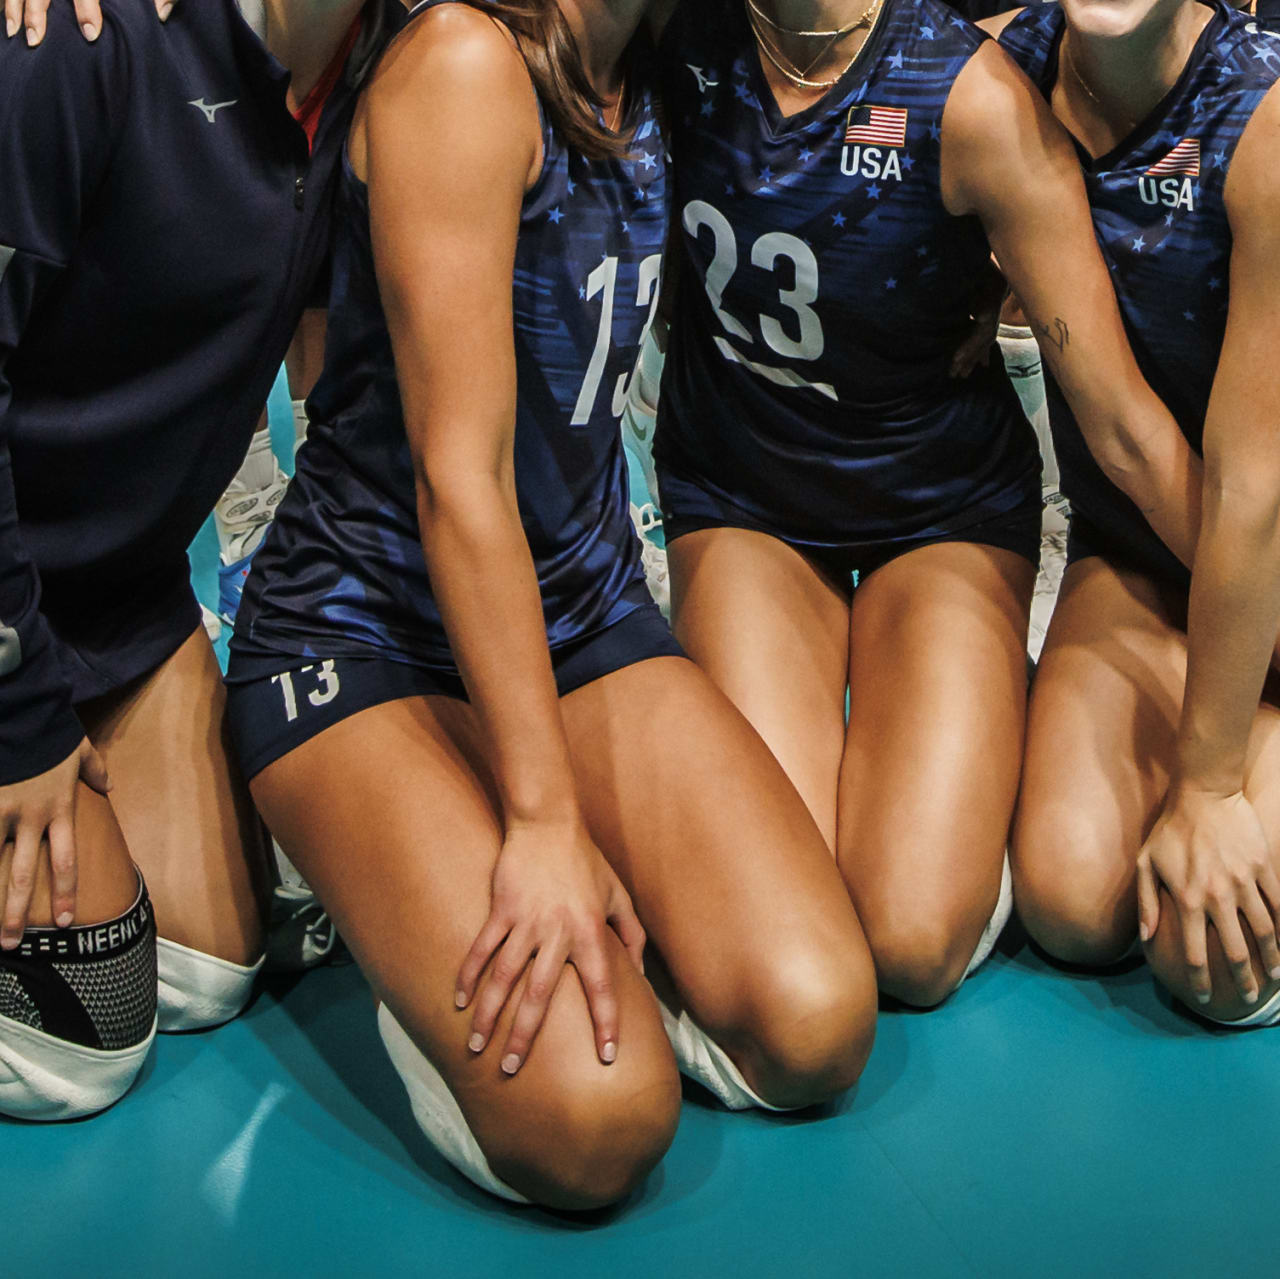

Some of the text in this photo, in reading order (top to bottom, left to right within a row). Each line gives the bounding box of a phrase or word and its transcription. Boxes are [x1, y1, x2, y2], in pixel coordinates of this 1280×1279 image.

[841, 146, 903, 182] USA
[1138, 177, 1194, 212] USA
[682, 199, 824, 362] 23
[271, 658, 340, 722] 13
